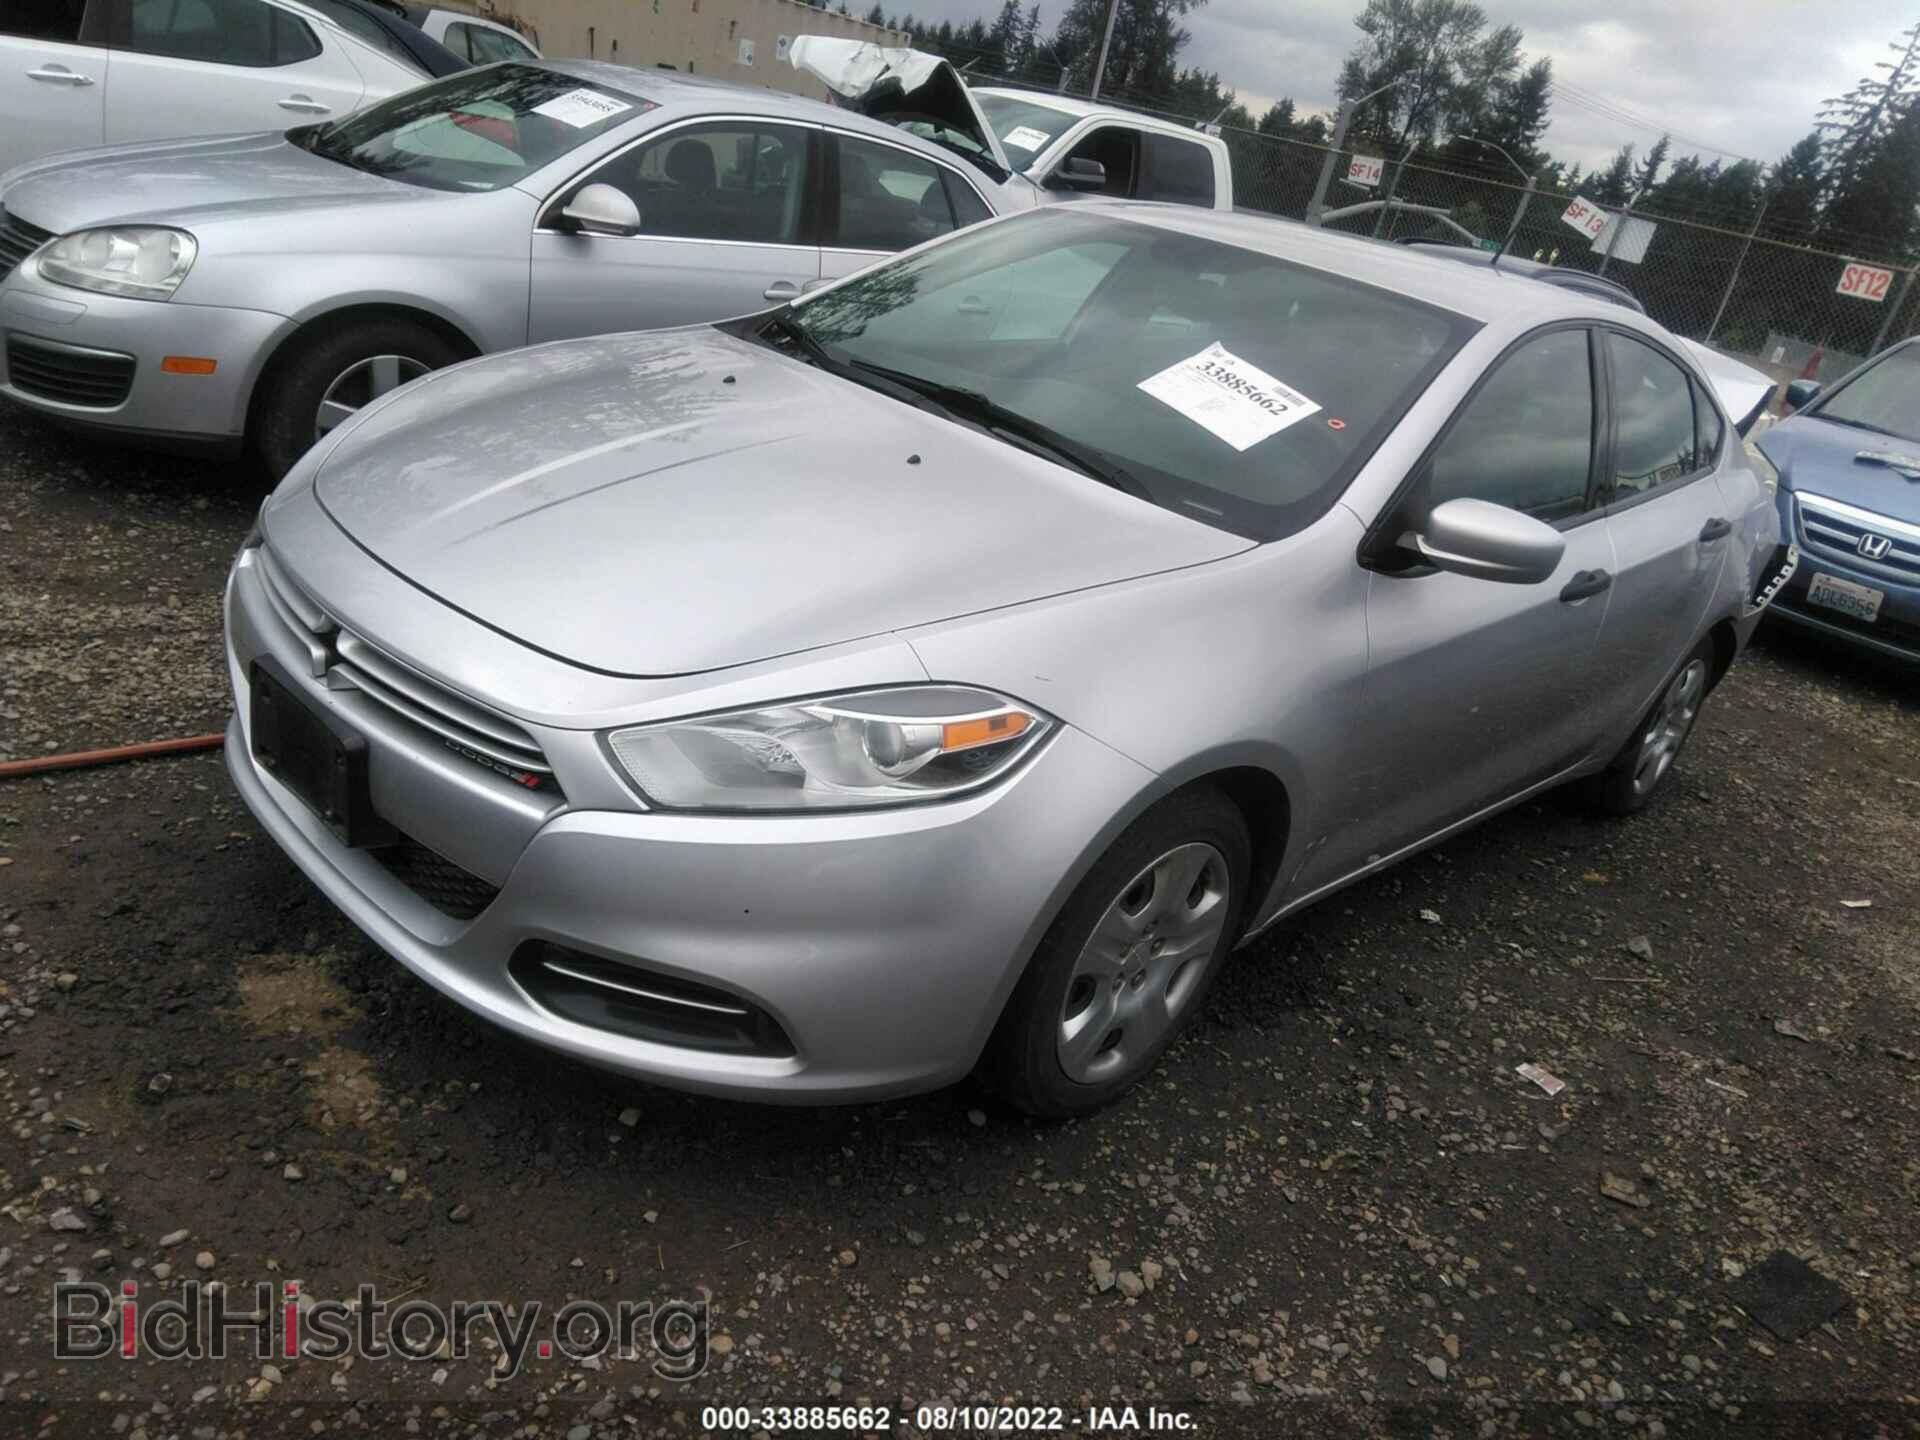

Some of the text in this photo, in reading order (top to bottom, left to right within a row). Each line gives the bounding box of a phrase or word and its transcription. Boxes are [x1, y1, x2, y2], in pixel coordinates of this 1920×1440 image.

[1349, 163, 1381, 180] SF14
[1567, 202, 1604, 233] SF13
[1841, 266, 1889, 297] SF12
[1196, 360, 1288, 416] 33885662
